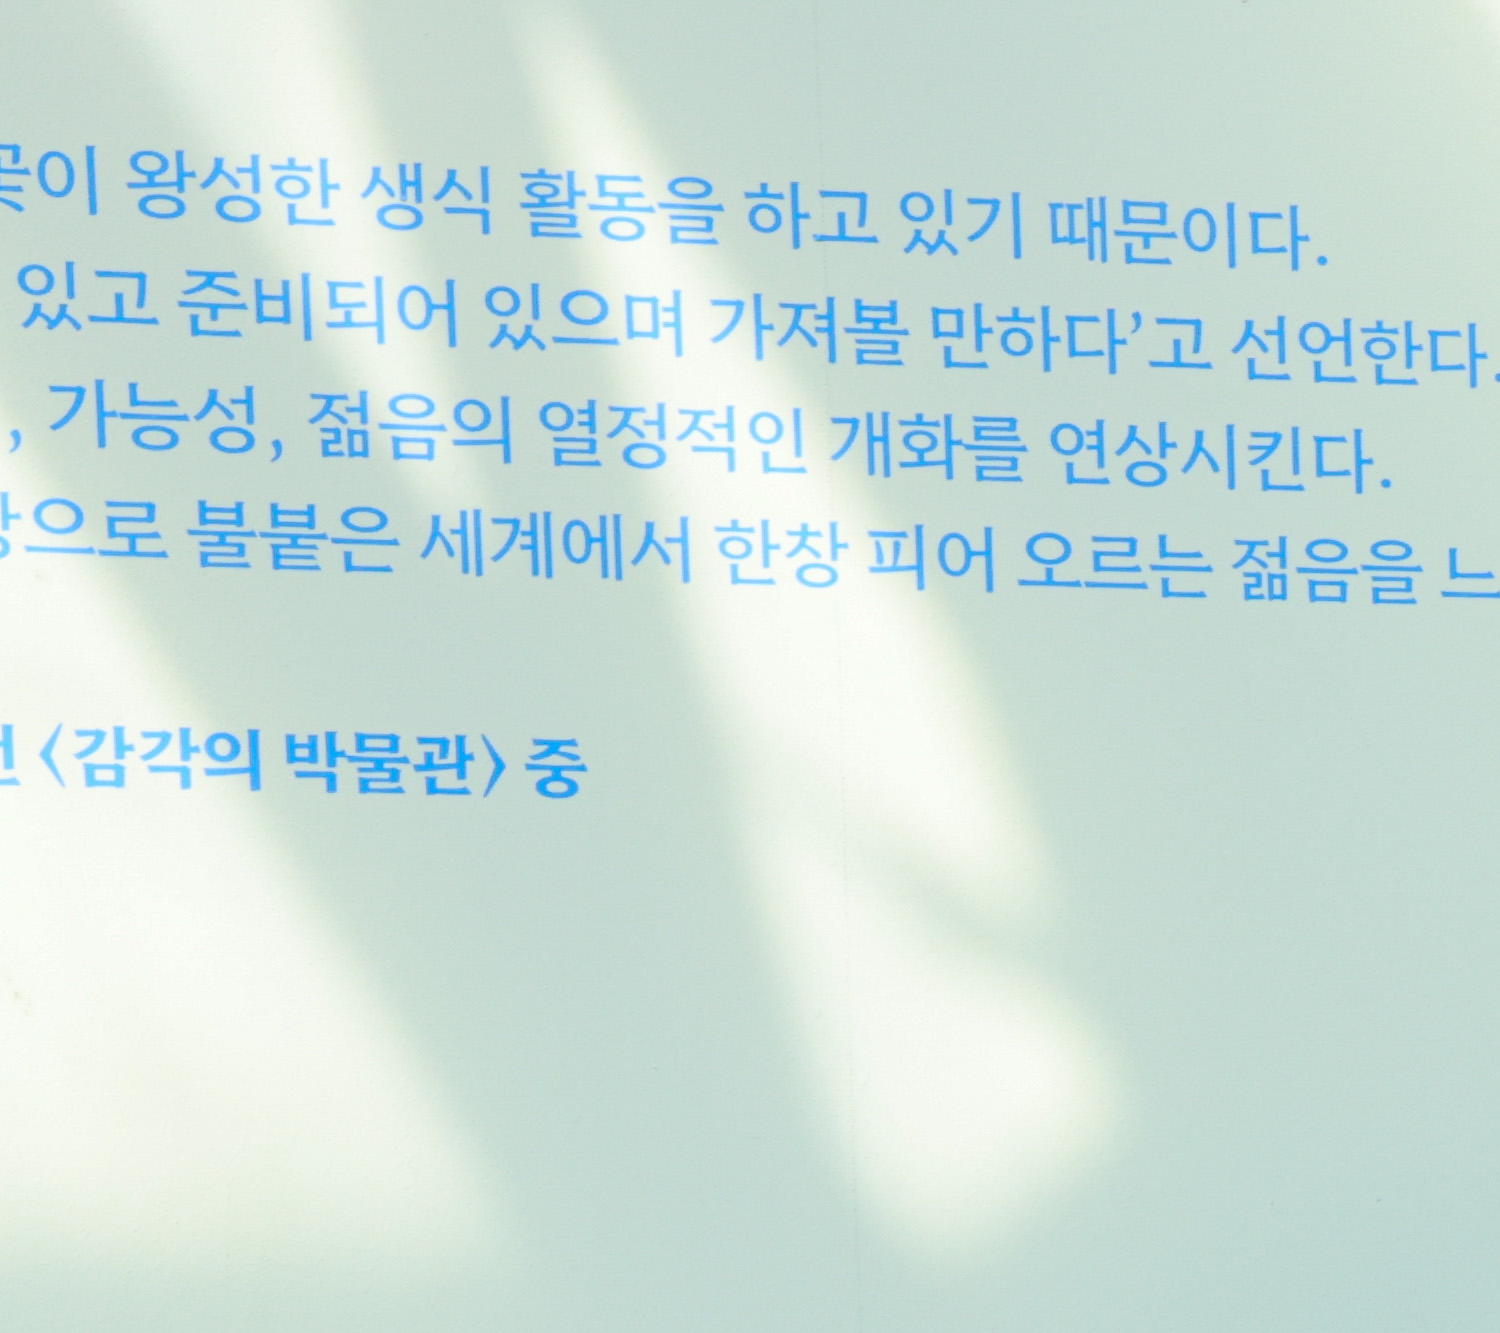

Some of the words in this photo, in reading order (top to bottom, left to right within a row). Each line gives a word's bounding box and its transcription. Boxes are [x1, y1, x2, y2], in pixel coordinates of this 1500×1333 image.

[126, 149, 340, 226] 왕성한
[362, 162, 492, 236] 생식
[520, 168, 726, 245] 활동을
[744, 181, 880, 250] 하고
[898, 188, 1024, 260] 있기
[1048, 195, 1328, 272] 때문이다.
[16, 260, 160, 331] 있고
[176, 269, 458, 348] 준비되어
[484, 282, 684, 357] 있으며
[711, 293, 912, 367] 가져볼
[48, 378, 284, 462] 가능성,
[308, 390, 512, 464] 젊음의
[538, 399, 807, 474] 열정적인
[831, 411, 1030, 483] 개화를
[1049, 418, 1392, 495] 연상시킨다.
[186, 499, 400, 574] 불붙은
[420, 508, 692, 584] 세계에서
[714, 519, 849, 588] 한창
[868, 523, 996, 594] 피어
[1016, 531, 1214, 599] 오르는
[1232, 535, 1424, 606] 젊음을
[524, 738, 588, 800] 중
